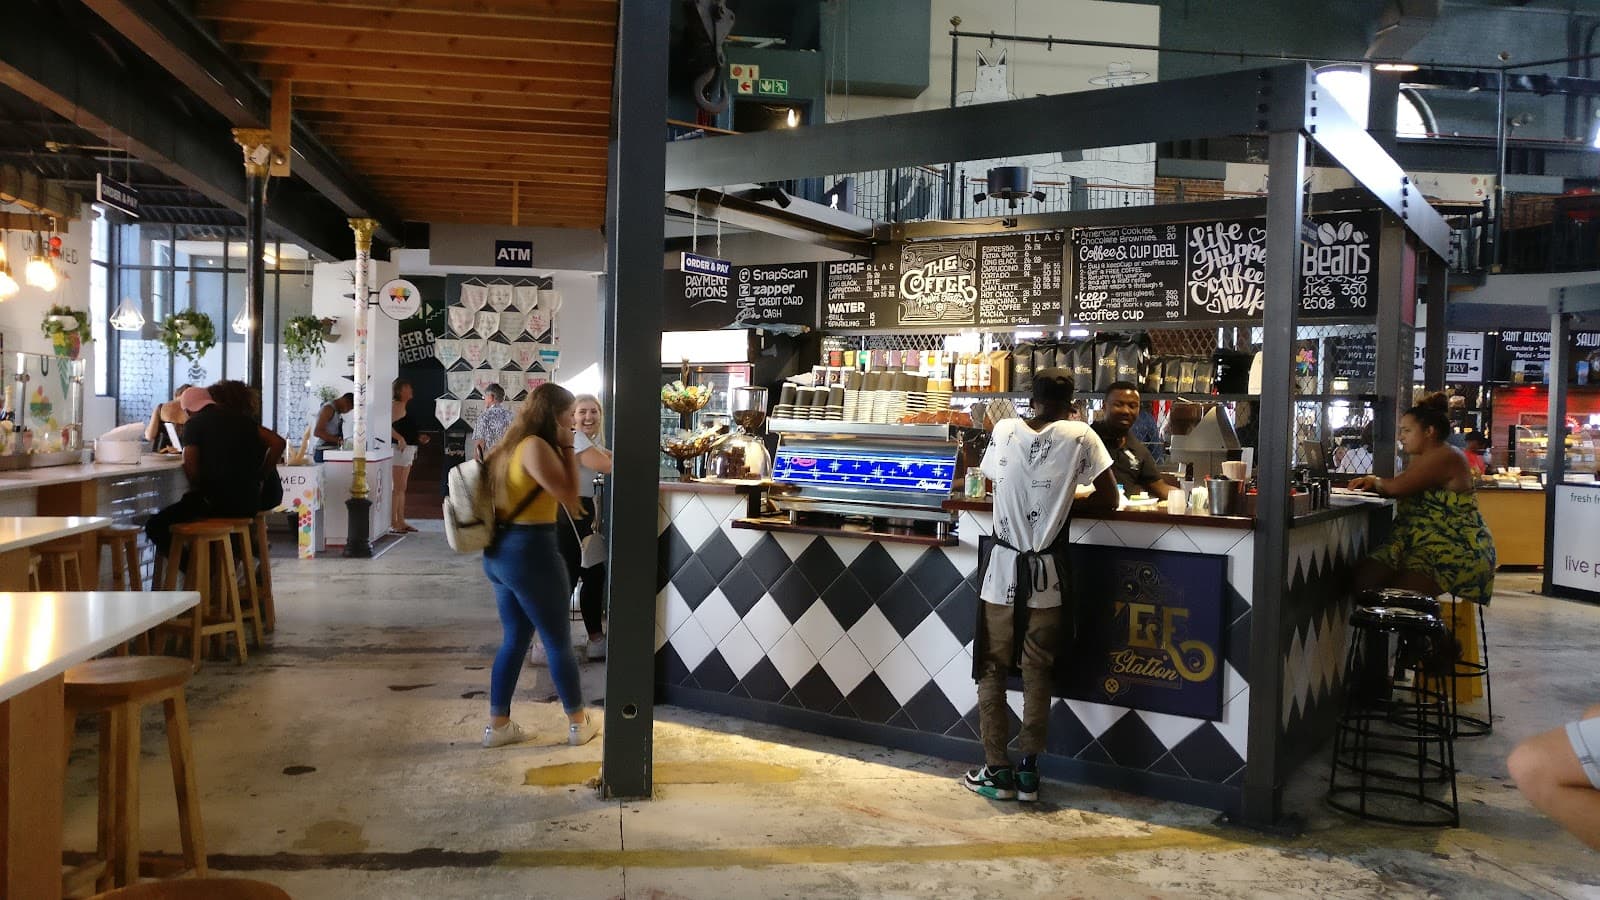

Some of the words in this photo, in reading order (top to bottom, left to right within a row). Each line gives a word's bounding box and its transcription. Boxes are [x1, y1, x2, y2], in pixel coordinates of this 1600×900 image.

[1035, 234, 1039, 242] L
[1120, 235, 1157, 243] Brownies
[1189, 222, 1242, 264] Life
[497, 248, 531, 260] ATM
[1080, 246, 1116, 261] Coffee
[1116, 246, 1127, 260] &
[1130, 245, 1150, 258] CUP
[686, 258, 709, 270] ORDER
[711, 262, 715, 271] &
[716, 264, 729, 274] PAY
[830, 262, 865, 274] DECAF
[924, 255, 958, 276] THE
[1192, 244, 1266, 281] Happe
[753, 268, 808, 281] SnapScan
[685, 276, 728, 287] PAYMENT
[685, 286, 728, 298] OPTIONS
[752, 284, 795, 296] zapper
[1340, 284, 1367, 295] 350
[759, 297, 781, 306] CREDIT
[783, 296, 803, 305] CARD
[1080, 292, 1108, 301] keep
[1214, 284, 1264, 315] help
[1303, 297, 1335, 309] 250g
[1350, 296, 1366, 308] 90
[828, 302, 865, 313] WATER
[1080, 300, 1101, 310] cup
[763, 309, 782, 318] CASH
[1079, 309, 1119, 321] ecoffee
[1122, 310, 1144, 320] cup
[425, 328, 434, 342] &
[1524, 332, 1552, 342] ALESSAN
[1576, 333, 1600, 346] SALU
[1570, 493, 1591, 503] fresh
[1565, 556, 1590, 573] live
[1110, 649, 1178, 681] Station
